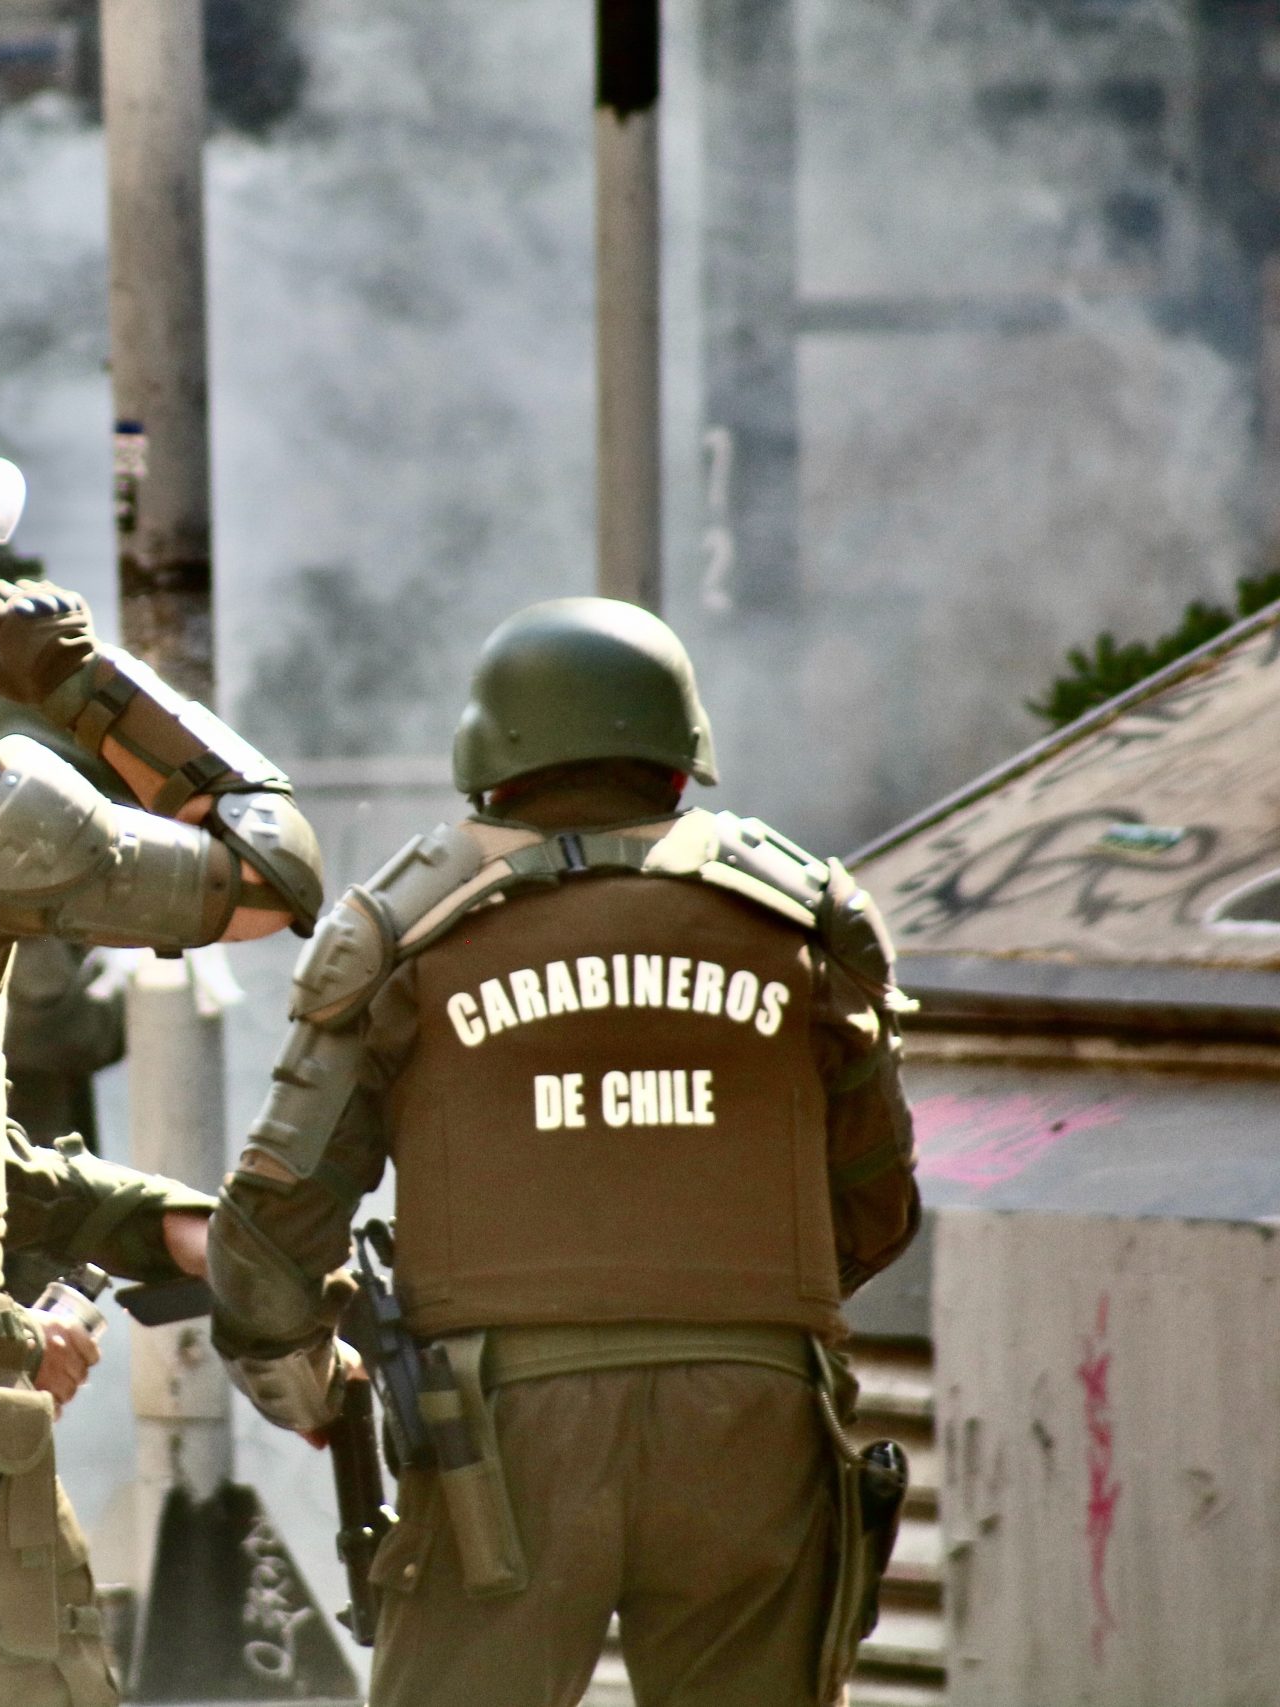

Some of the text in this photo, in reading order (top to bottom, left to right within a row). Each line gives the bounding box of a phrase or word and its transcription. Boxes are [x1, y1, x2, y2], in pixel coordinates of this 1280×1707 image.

[447, 953, 790, 1048] CARABINEROS
[534, 1069, 716, 1130] DE CHILE
